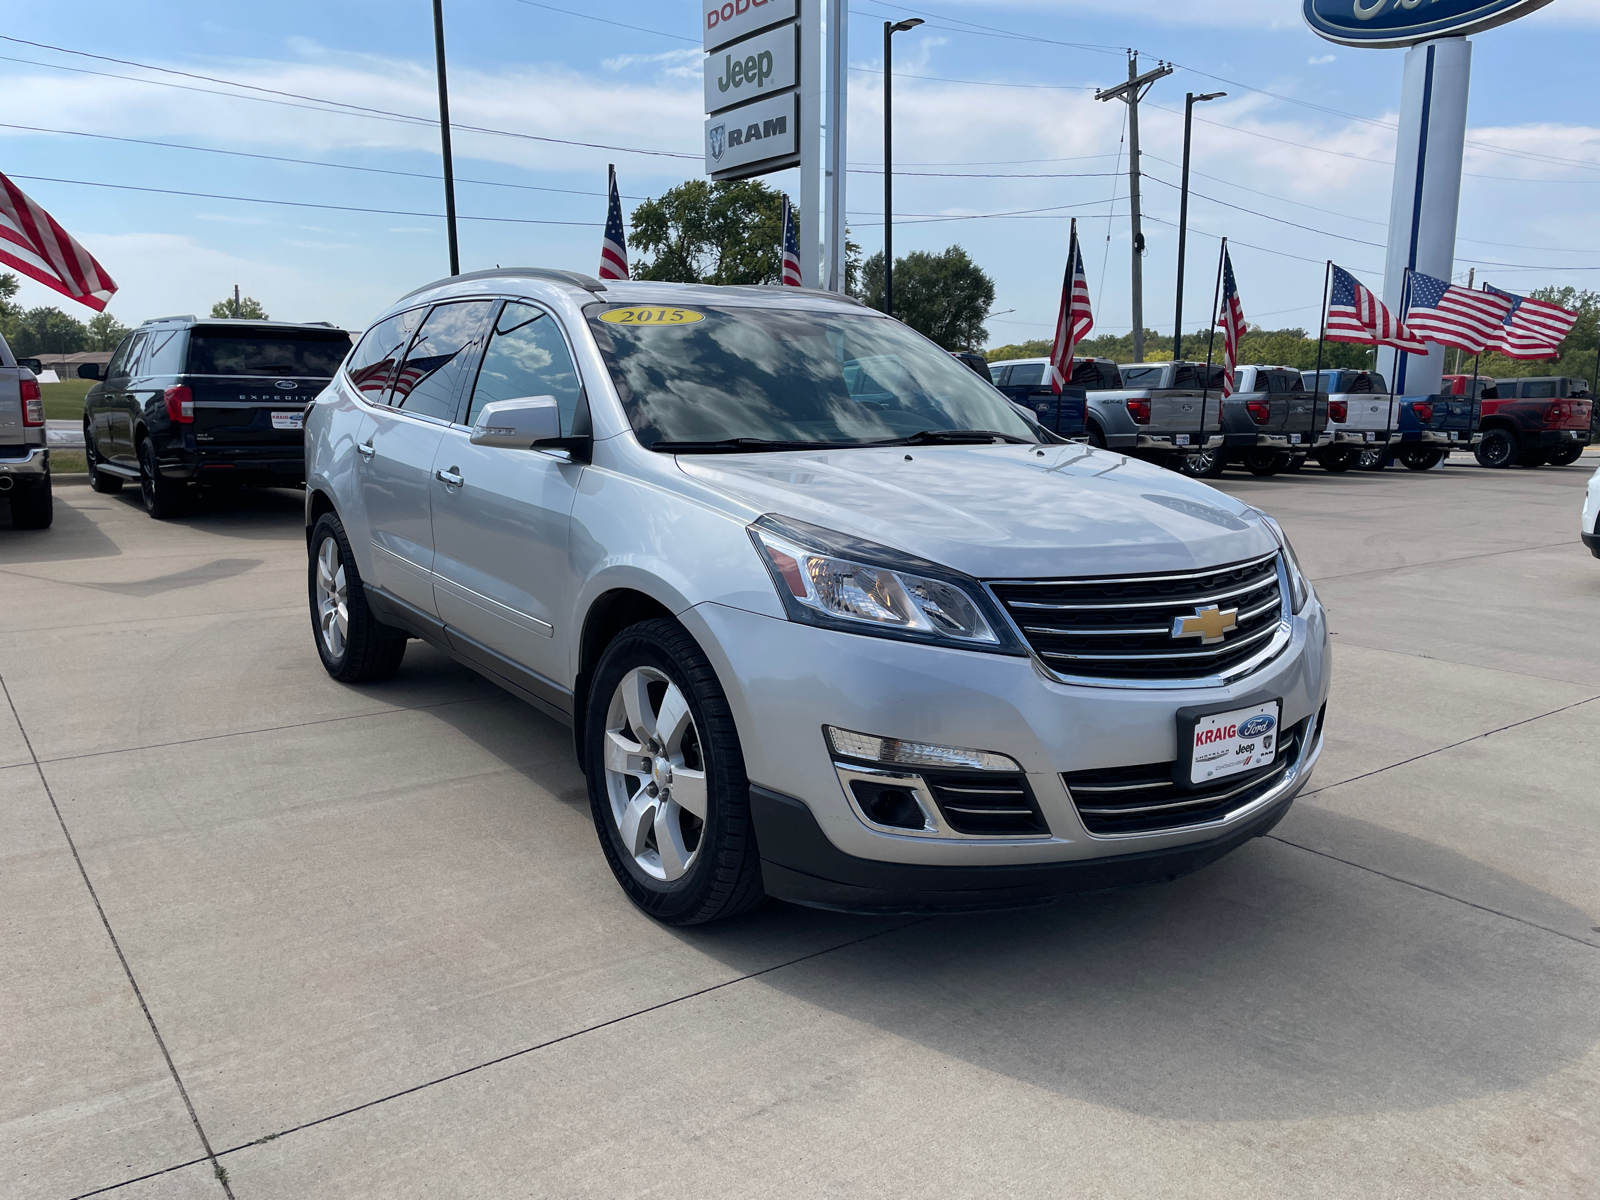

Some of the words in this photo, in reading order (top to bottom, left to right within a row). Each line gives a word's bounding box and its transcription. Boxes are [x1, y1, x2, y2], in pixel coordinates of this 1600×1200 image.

[707, 0, 775, 30] DOD
[718, 50, 773, 92] Jeep
[728, 115, 787, 148] RAM
[619, 310, 685, 323] 2015
[1195, 724, 1237, 747] KRAIG
[1195, 749, 1230, 760] CHRYSLER
[1236, 743, 1255, 755] Jeep
